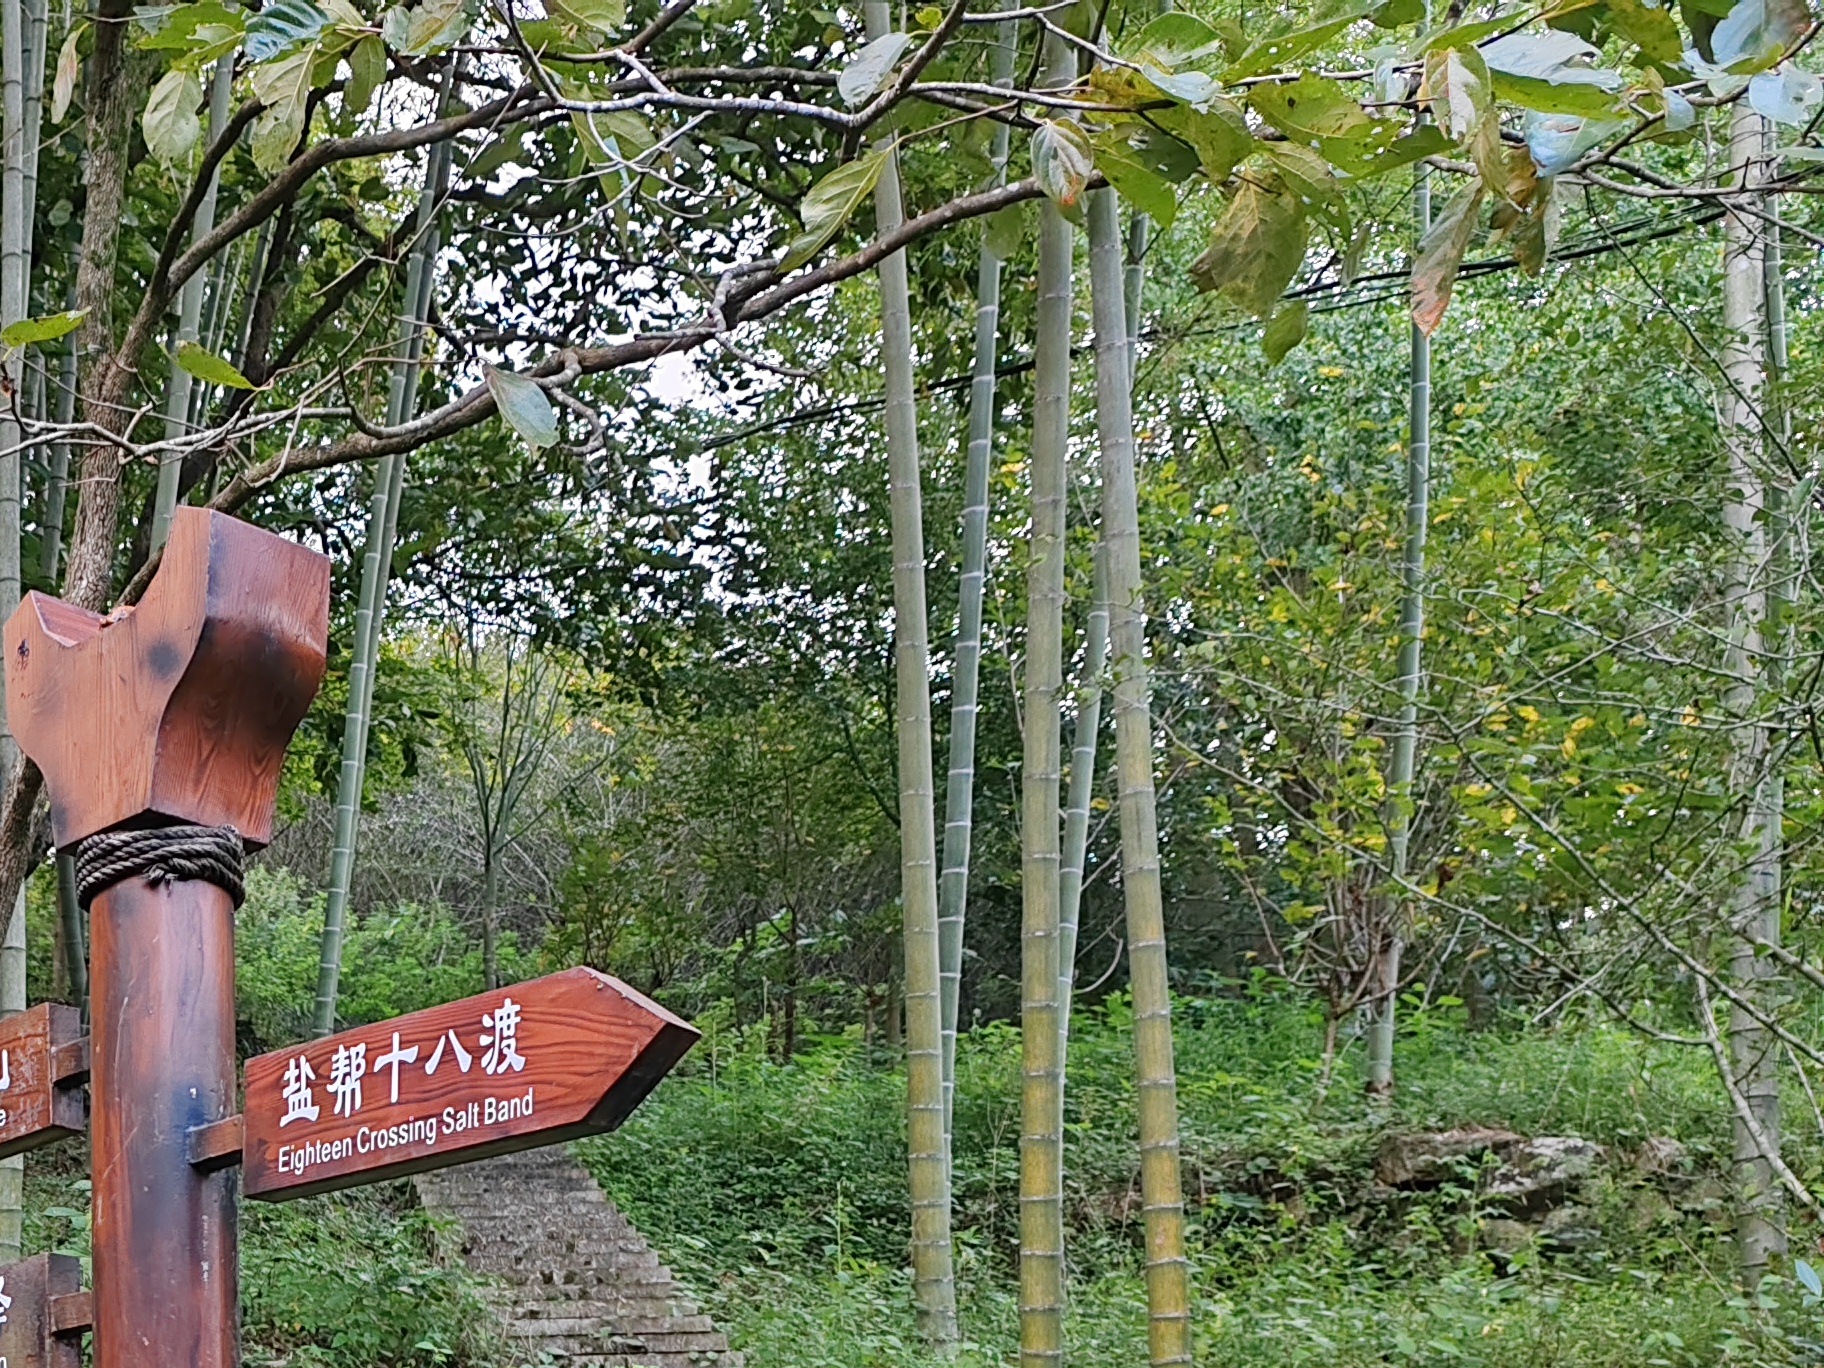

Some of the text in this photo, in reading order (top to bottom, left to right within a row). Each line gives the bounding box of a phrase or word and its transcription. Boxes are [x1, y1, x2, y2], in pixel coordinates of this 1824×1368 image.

[279, 997, 527, 1128] 盐帮十八渡
[278, 1086, 534, 1176] Eighteen Crossing Salt Band
